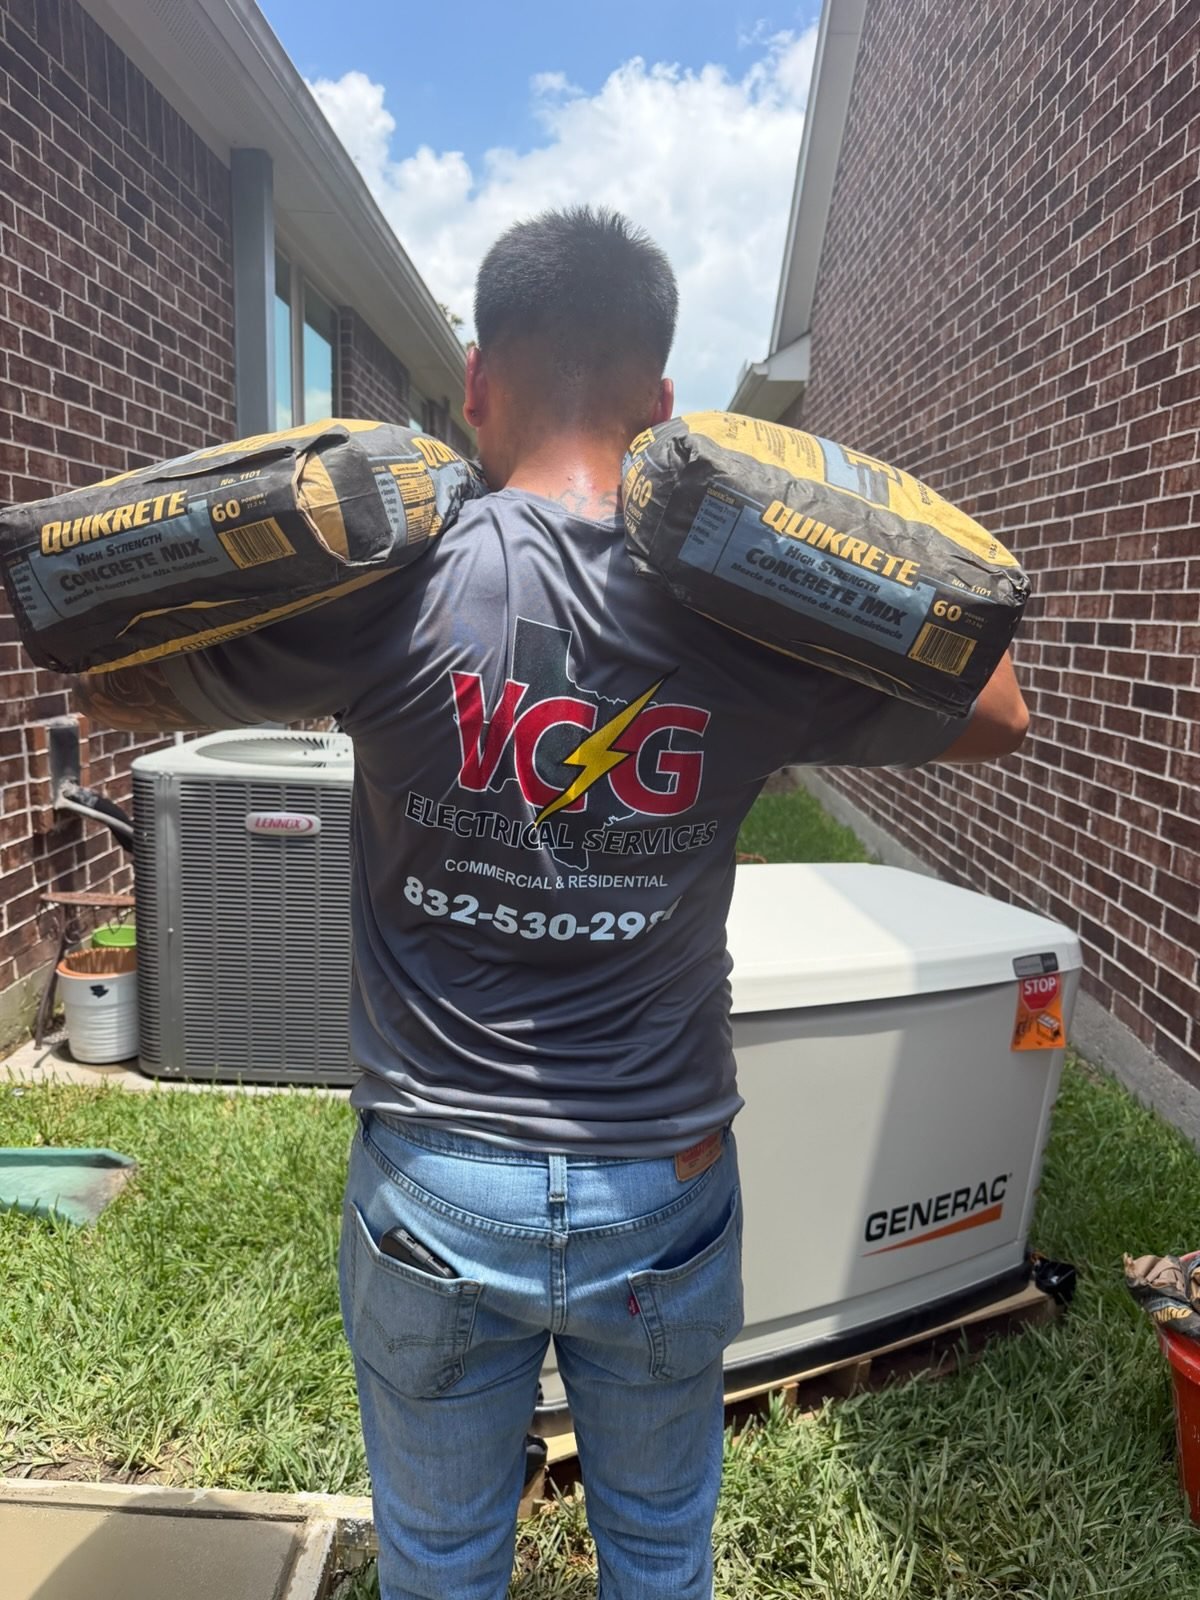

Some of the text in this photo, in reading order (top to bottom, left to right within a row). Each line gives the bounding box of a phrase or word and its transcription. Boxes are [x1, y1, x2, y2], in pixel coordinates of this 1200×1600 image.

[220, 469, 261, 487] No. 1101
[41, 489, 189, 555] QUIKRETE
[212, 499, 241, 523] 60
[76, 533, 163, 567] HIGH STRENGTH
[761, 499, 921, 587] QUIKRETE
[59, 552, 159, 591] CONCRETE
[160, 538, 206, 563] MIX
[784, 545, 881, 594] HIGH STRENGTH
[745, 547, 908, 627] CONCRETE MIX
[778, 583, 817, 606] Concreto
[951, 577, 992, 598] No. 1101
[933, 599, 962, 622] 60
[449, 671, 711, 817] VCG
[255, 816, 301, 829] LENNOX
[405, 791, 718, 855] ELECTRICAL SERVICES
[444, 859, 668, 890] COMMERCIAL & RESIDENTIAL
[1024, 977, 1057, 996] STOP
[864, 1174, 1008, 1242] GENERAC
